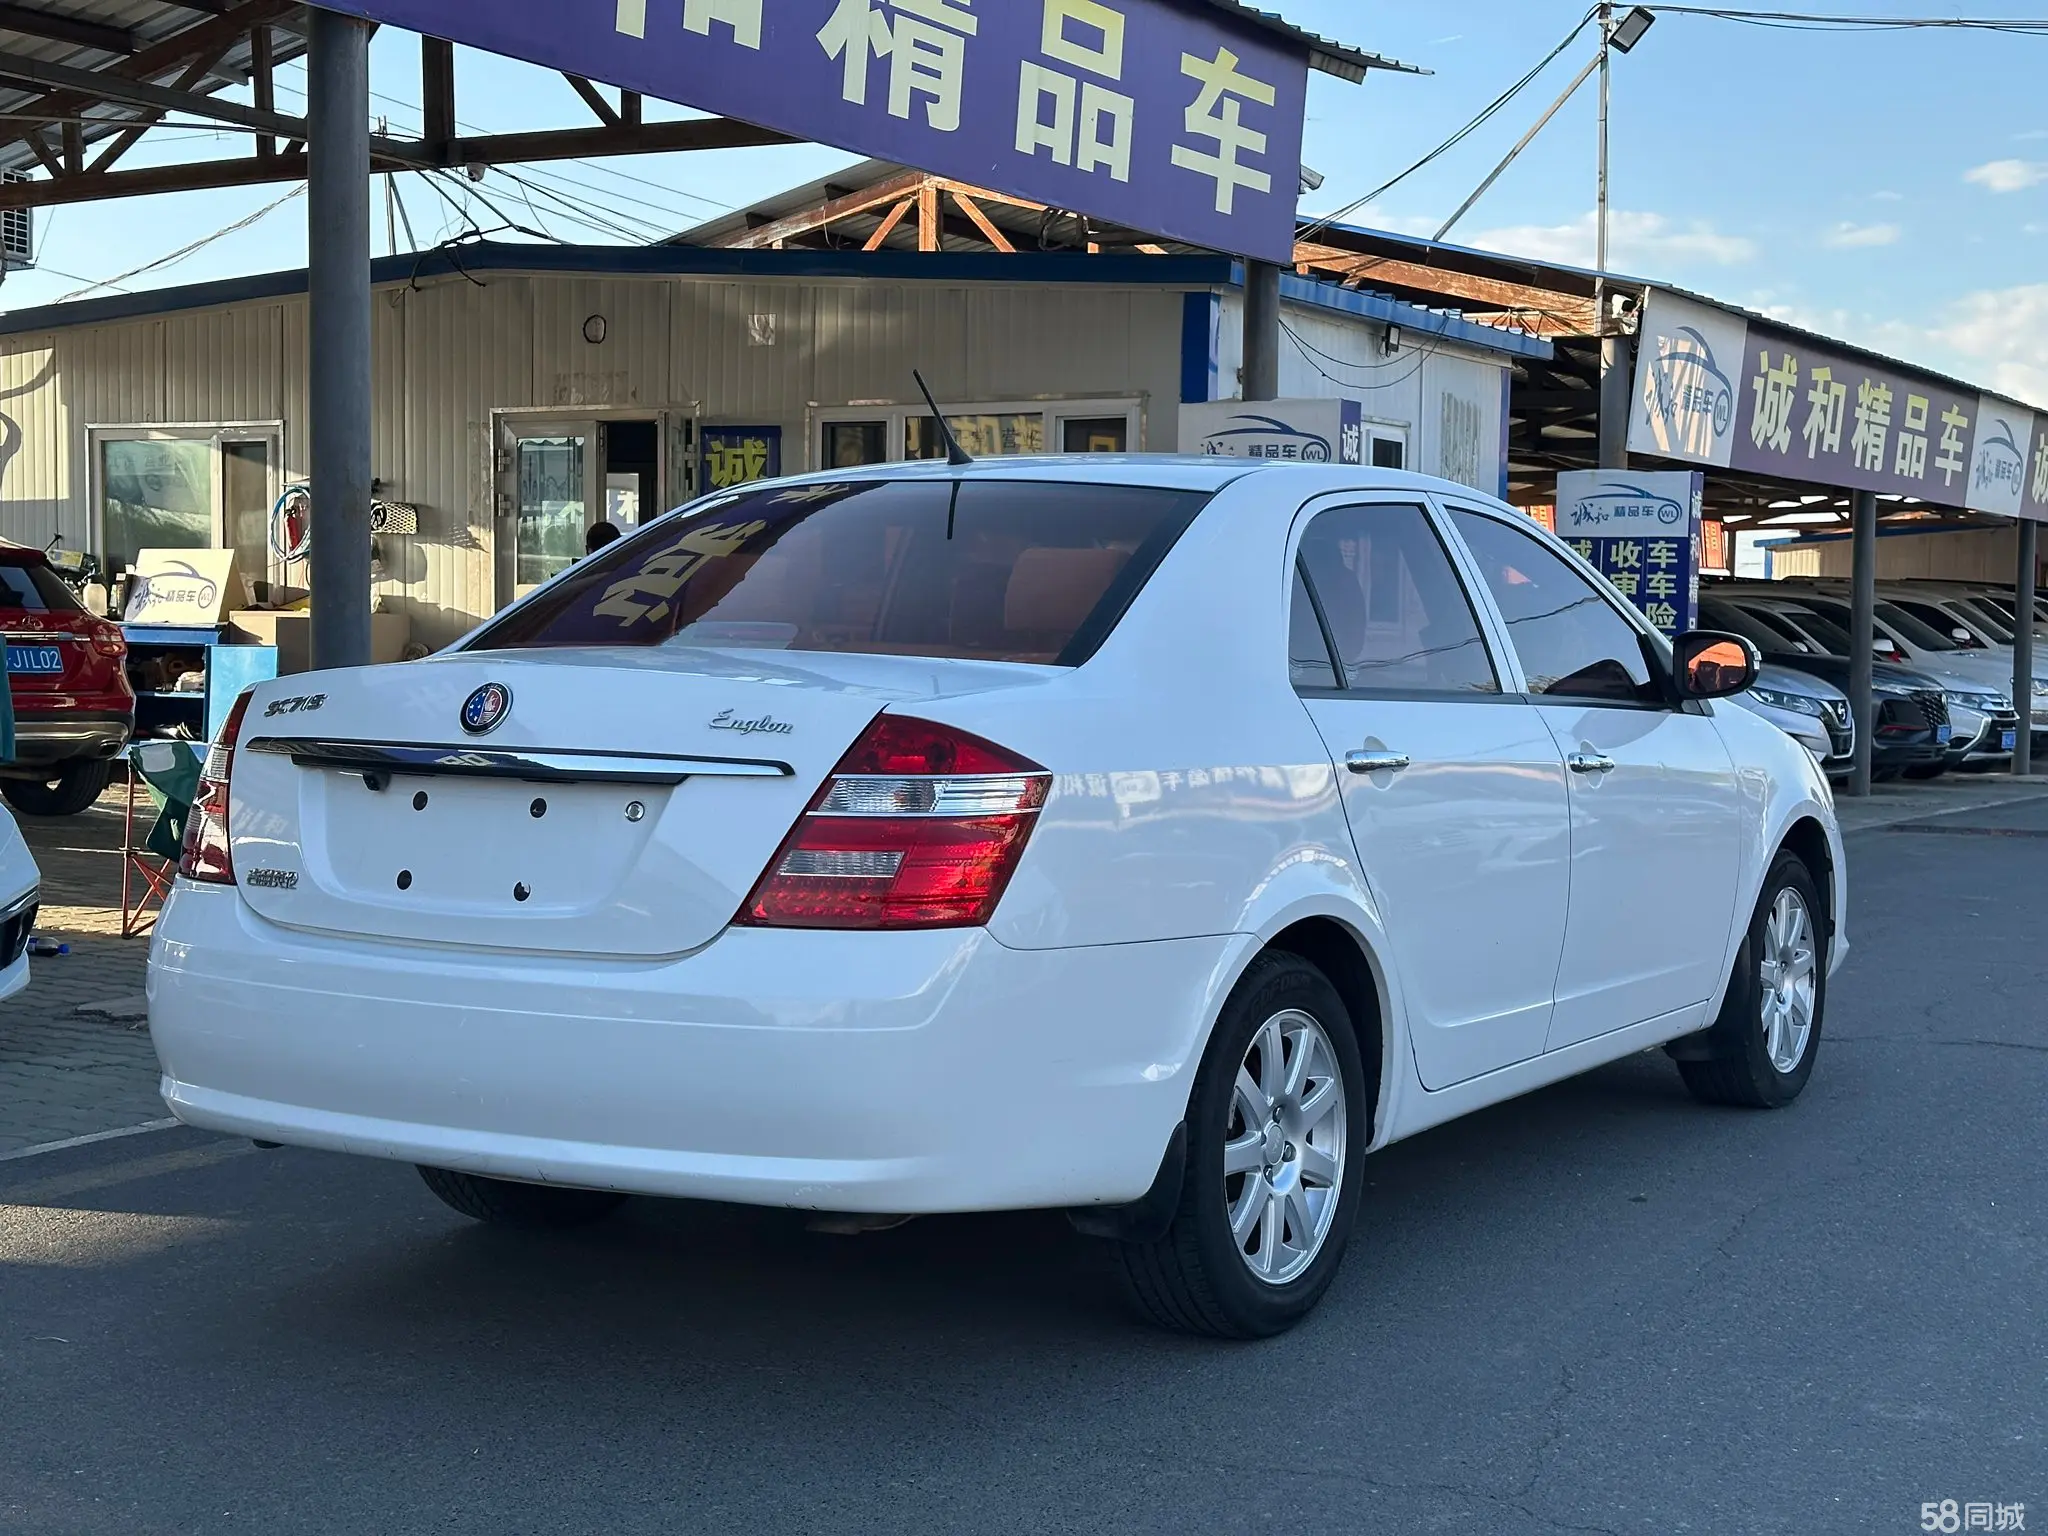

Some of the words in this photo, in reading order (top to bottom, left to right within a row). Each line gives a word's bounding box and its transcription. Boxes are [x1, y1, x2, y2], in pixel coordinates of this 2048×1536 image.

[1749, 350, 1968, 487] 诚和精品车
[706, 438, 768, 488] 诚
[1248, 444, 1297, 459] 精品车
[1305, 451, 1324, 461] WL
[1614, 505, 1654, 518] 精品车
[1661, 510, 1676, 518] WL
[708, 708, 793, 736] Englon
